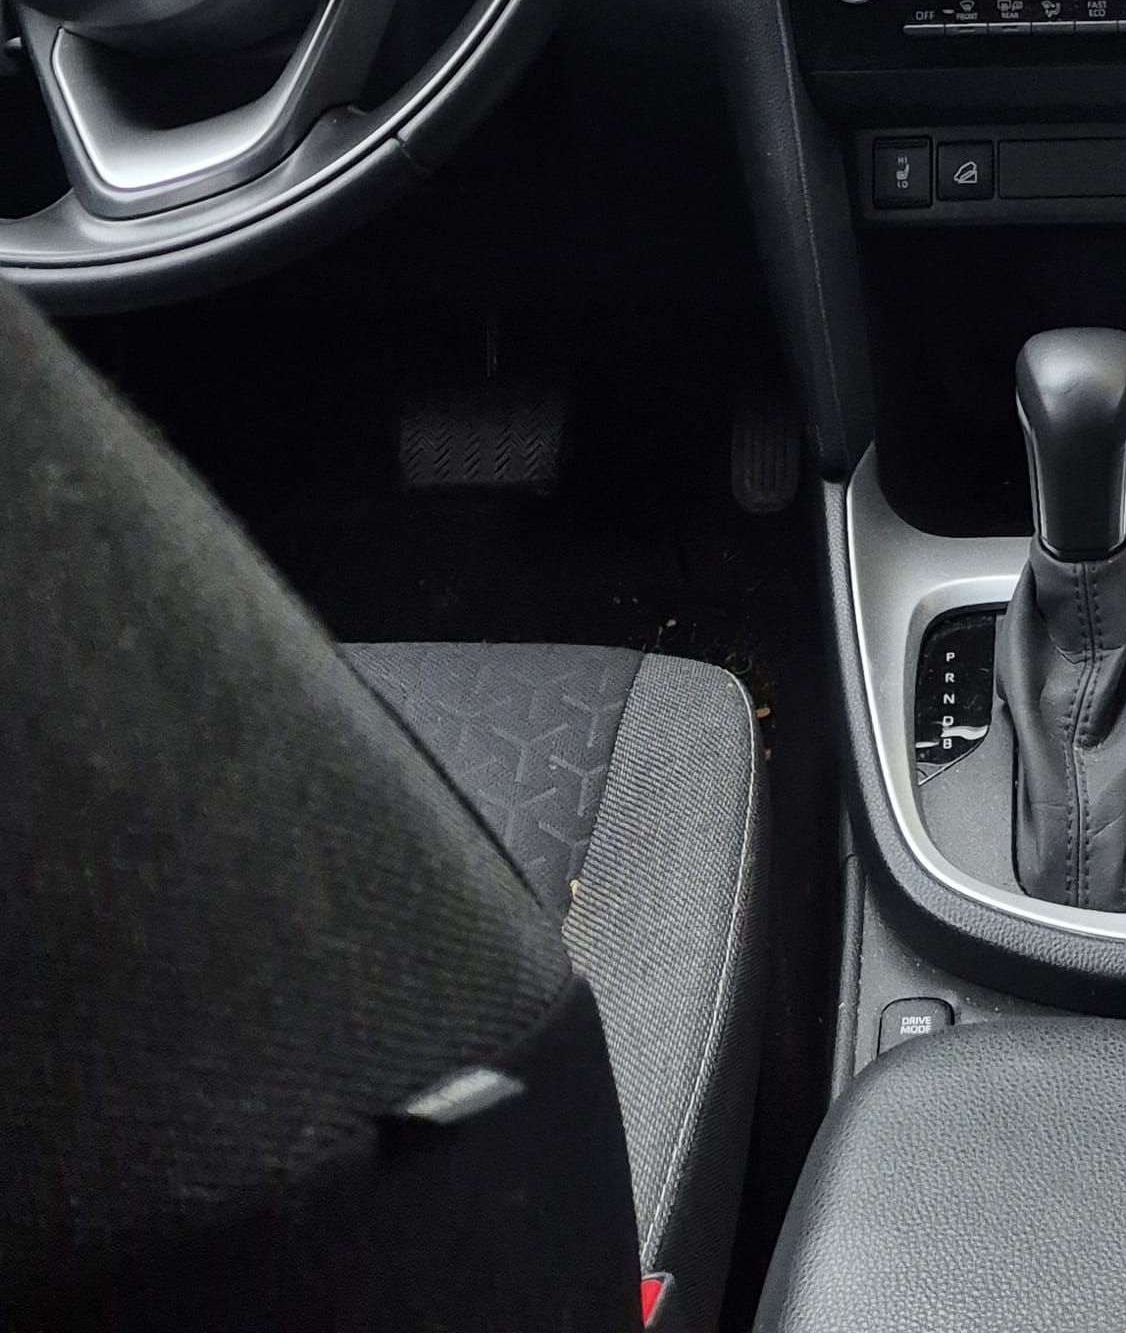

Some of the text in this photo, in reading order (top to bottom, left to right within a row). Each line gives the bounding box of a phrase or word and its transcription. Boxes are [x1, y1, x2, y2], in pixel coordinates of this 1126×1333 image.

[1087, 0, 1108, 9] FAST
[915, 10, 935, 21] OFF
[956, 12, 978, 20] FRONT
[1089, 9, 1106, 17] ECO
[897, 156, 908, 164] HI
[896, 181, 909, 189] LO
[946, 652, 956, 662] P
[945, 672, 955, 683] R
[943, 693, 955, 704] N
[942, 715, 954, 726] D
[942, 738, 953, 749] B
[901, 1015, 932, 1025] DRIVE
